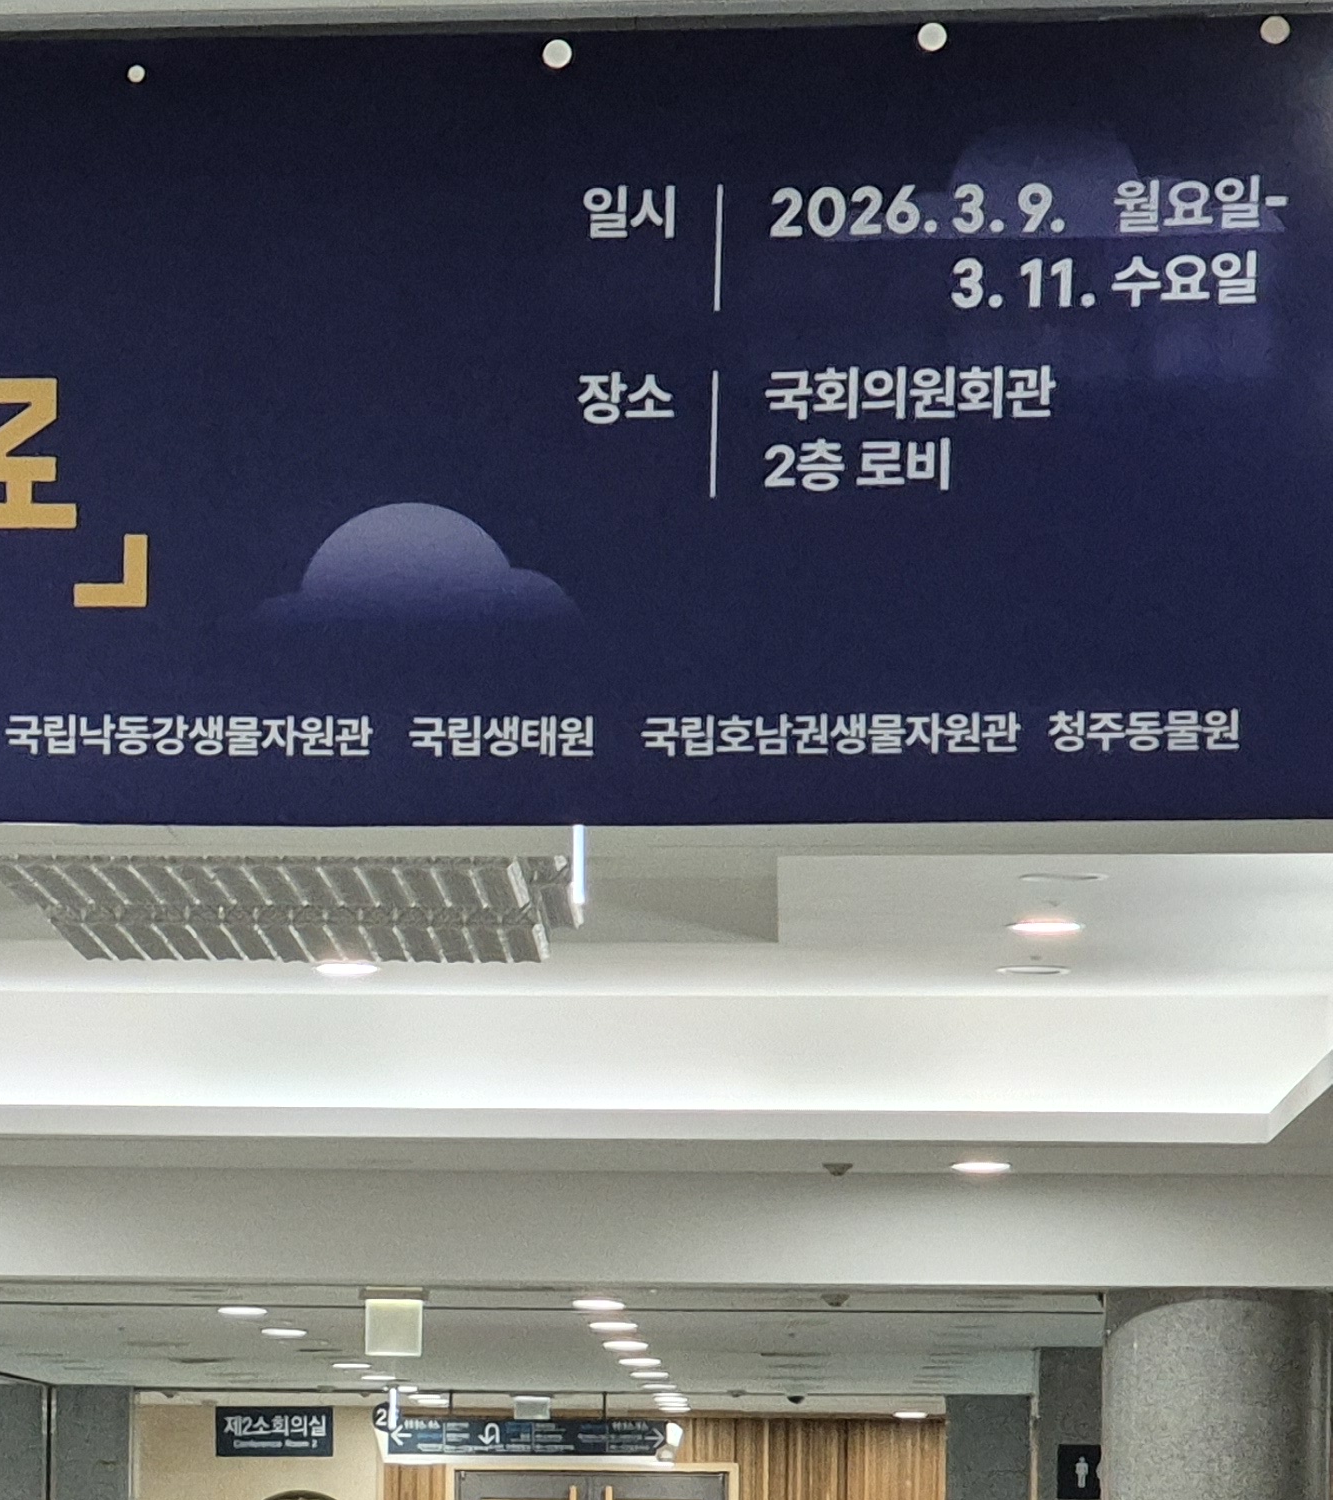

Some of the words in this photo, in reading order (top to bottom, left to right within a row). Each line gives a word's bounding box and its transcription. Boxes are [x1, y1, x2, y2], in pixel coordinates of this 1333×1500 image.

[583, 185, 676, 239] 일시
[1111, 250, 1258, 307] 수요일
[577, 371, 676, 425] 장소
[764, 365, 1057, 421] 국회의원회관
[764, 438, 845, 492] 2층
[856, 437, 952, 491] 로비
[5, 714, 374, 757] 국립낙동강생물자원관
[408, 715, 595, 757] 국립생태원
[641, 711, 1021, 757] 국립호남권생물자원관
[1048, 708, 1241, 752] 청주동물원
[223, 1414, 327, 1437] 제2소회의실
